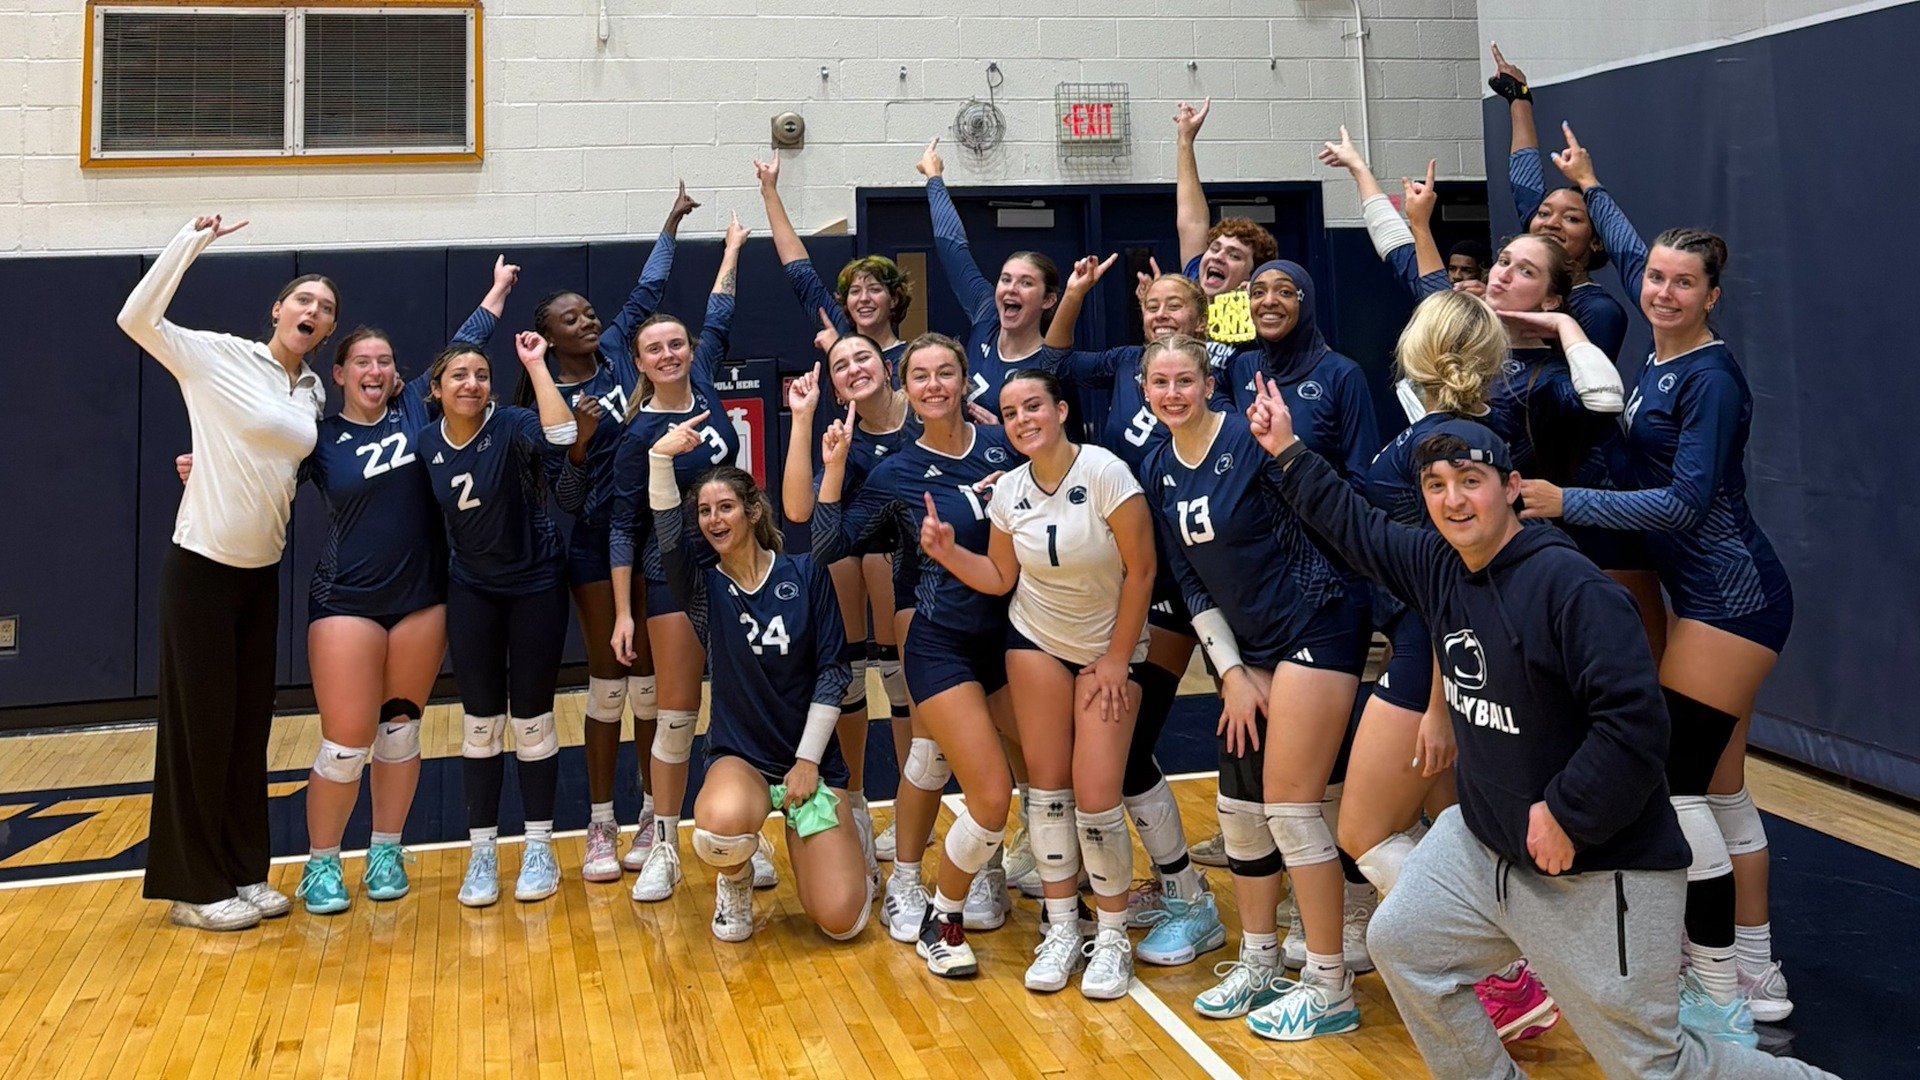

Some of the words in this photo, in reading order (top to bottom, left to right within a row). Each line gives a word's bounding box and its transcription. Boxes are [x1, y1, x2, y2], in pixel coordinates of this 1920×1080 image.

[1072, 103, 1112, 135] EXIT
[736, 380, 760, 389] HERE
[1124, 405, 1158, 447] 9
[355, 432, 417, 479] 22
[451, 472, 481, 511] 2
[1177, 495, 1215, 546] 13
[1046, 524, 1060, 567] 1
[739, 612, 790, 655] 24
